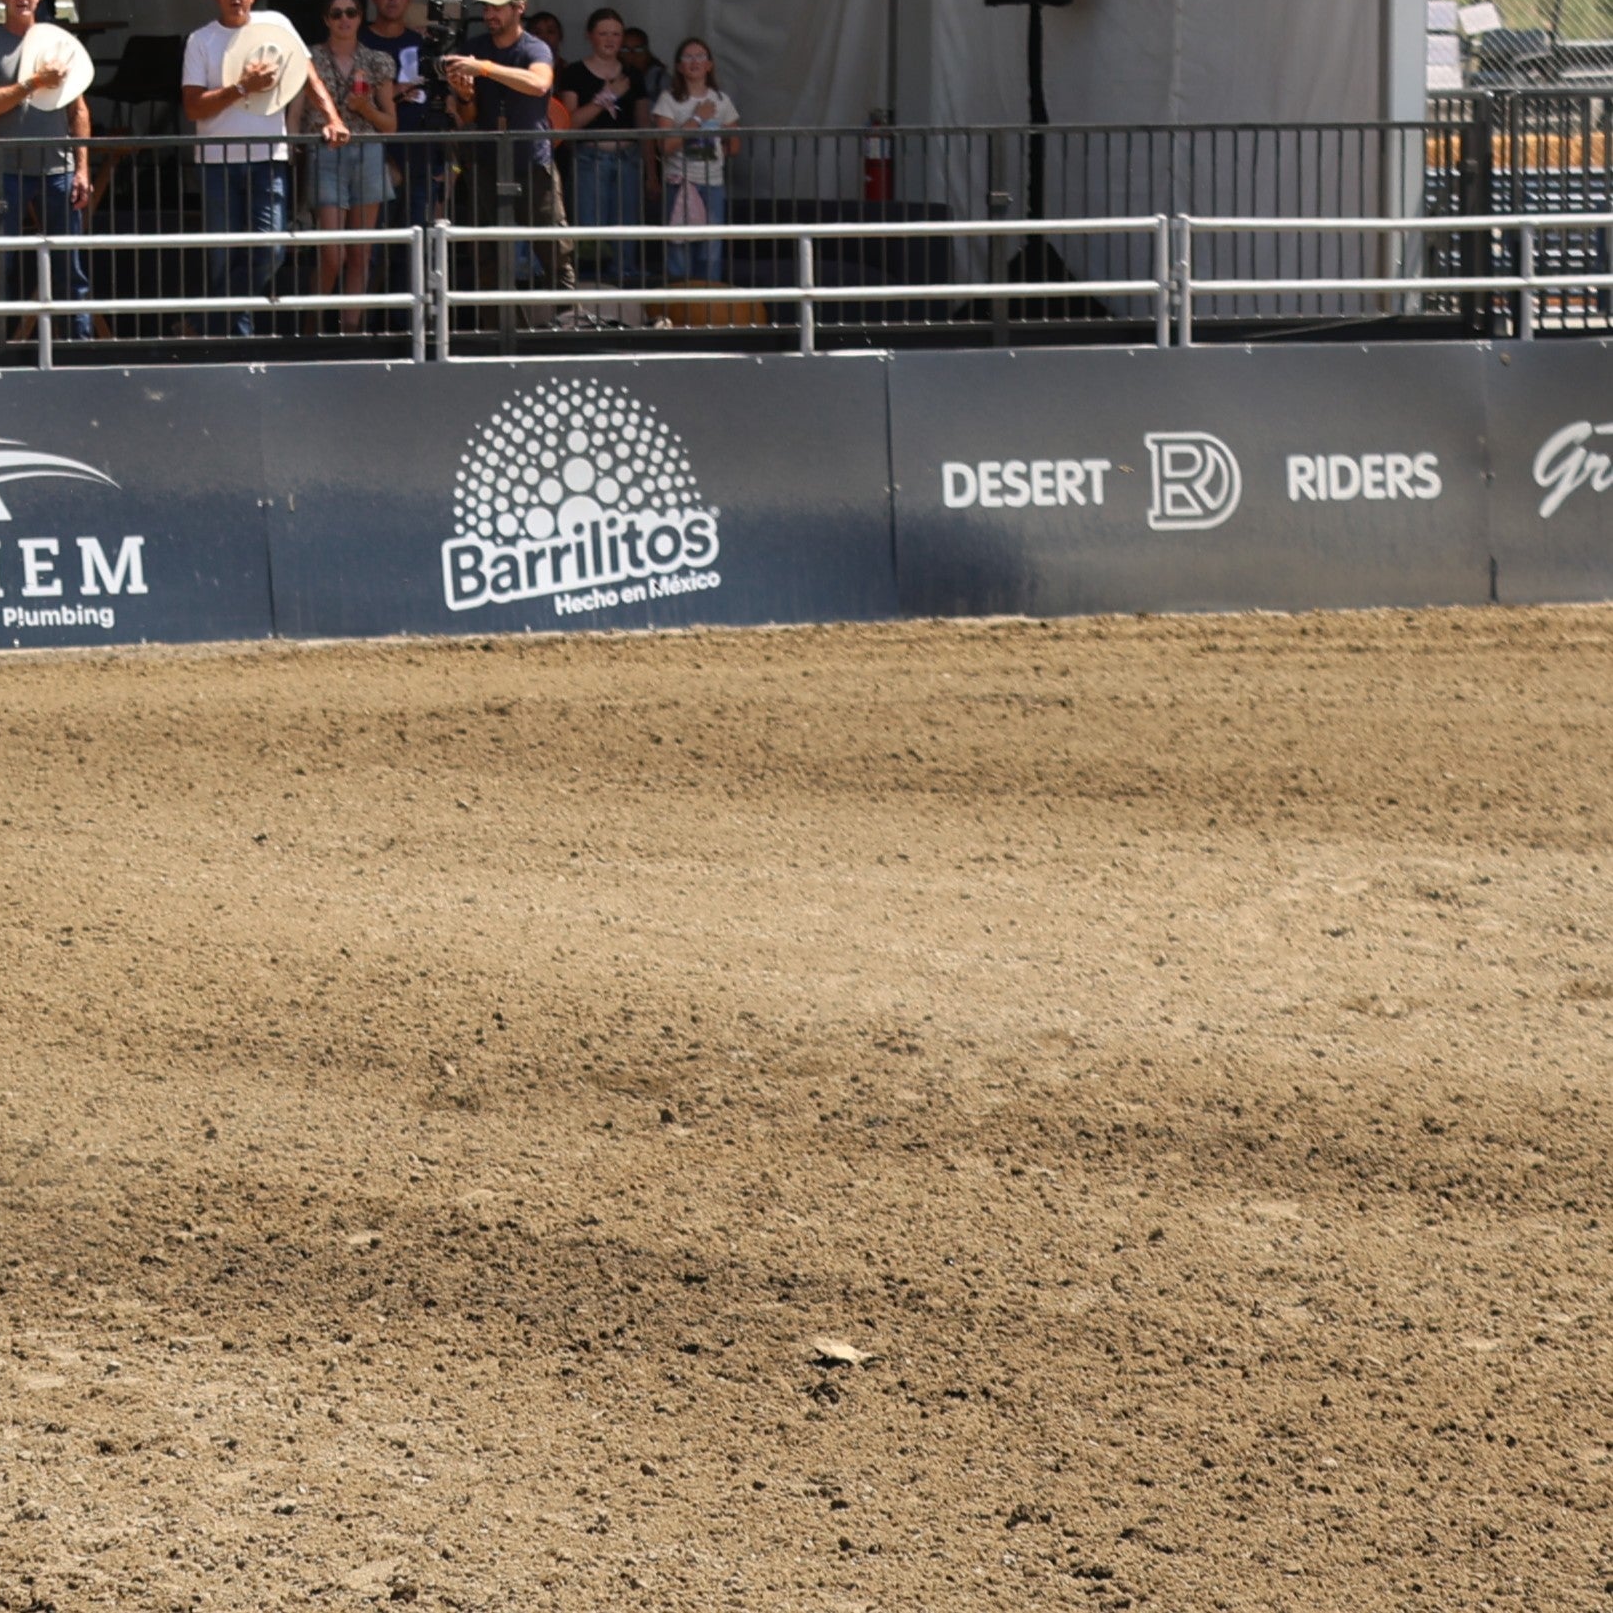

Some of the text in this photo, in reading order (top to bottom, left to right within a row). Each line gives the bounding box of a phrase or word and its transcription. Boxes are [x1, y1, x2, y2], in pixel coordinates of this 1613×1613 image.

[941, 458, 1113, 509] DESERT
[1286, 451, 1444, 502] RIDERS
[447, 514, 715, 604] Barrilitos
[2, 603, 116, 629] Plumbing
[553, 569, 723, 617] Hecho en México
